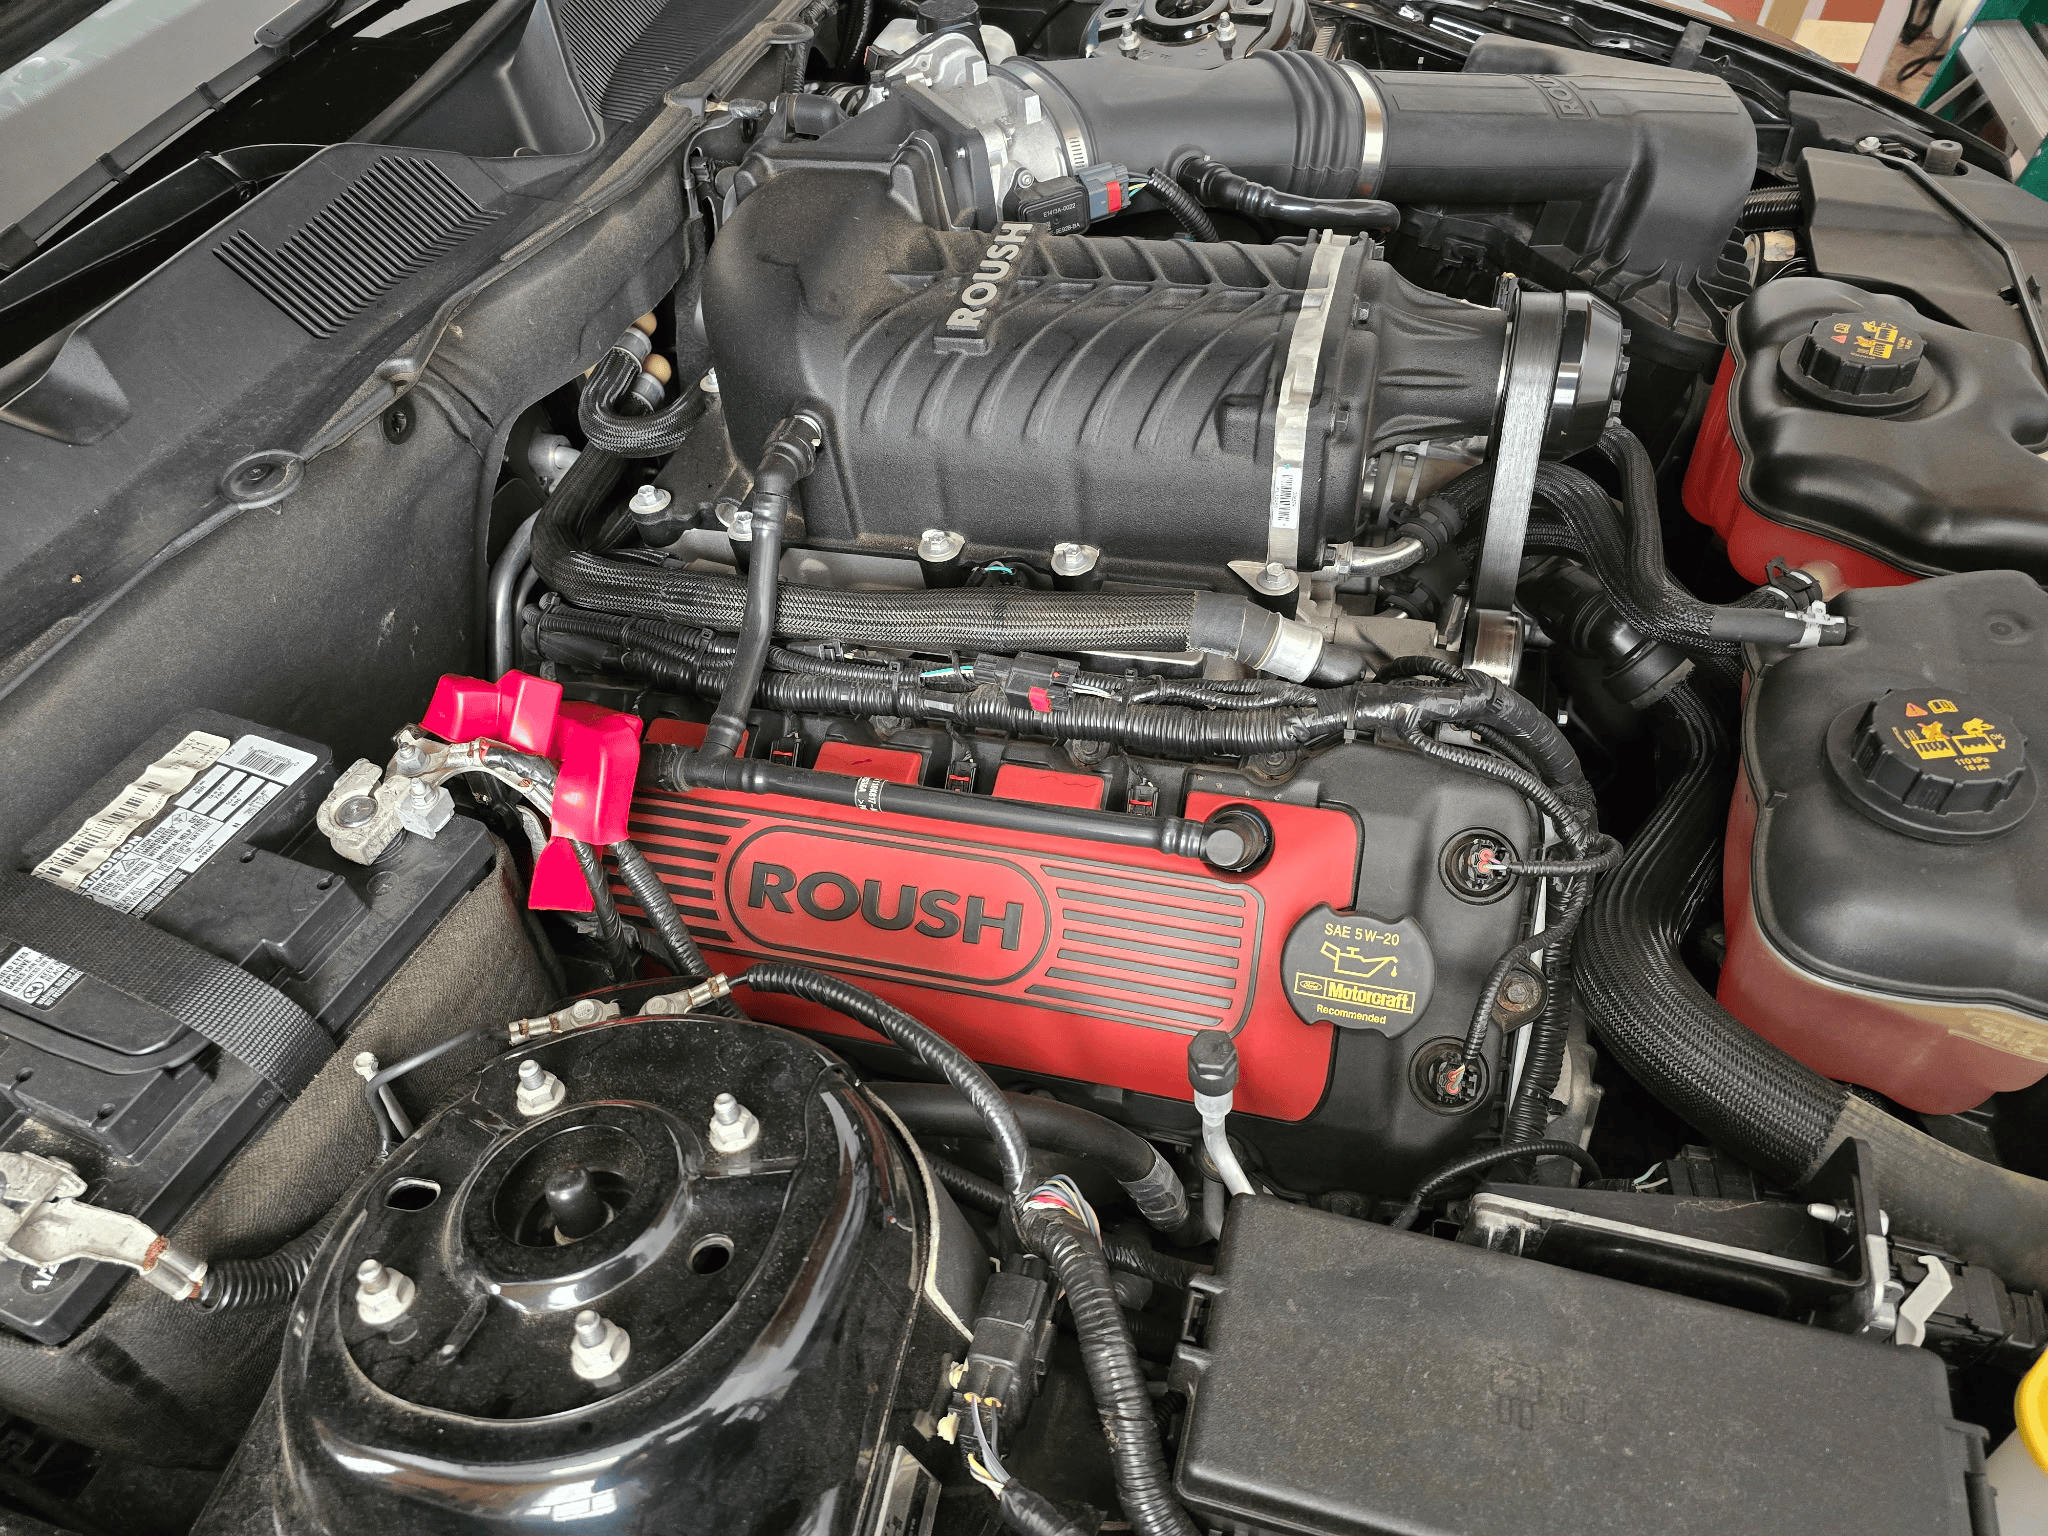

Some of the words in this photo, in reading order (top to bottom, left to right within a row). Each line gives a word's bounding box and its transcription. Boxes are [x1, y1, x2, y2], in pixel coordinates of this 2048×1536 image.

[946, 223, 1033, 327] ROUSH
[133, 838, 153, 852] FLUSH
[149, 826, 166, 838] EYES
[140, 825, 177, 855] IMMEDIATELY
[146, 844, 163, 857] WITH
[155, 840, 181, 860] MEDICAL
[177, 828, 194, 840] HELP
[91, 868, 120, 891] SULFURIC
[748, 861, 1024, 951] ROUSH
[1324, 922, 1351, 939] SAE
[1355, 928, 1400, 946] 5W-20
[1316, 1004, 1387, 1025] Recommended
